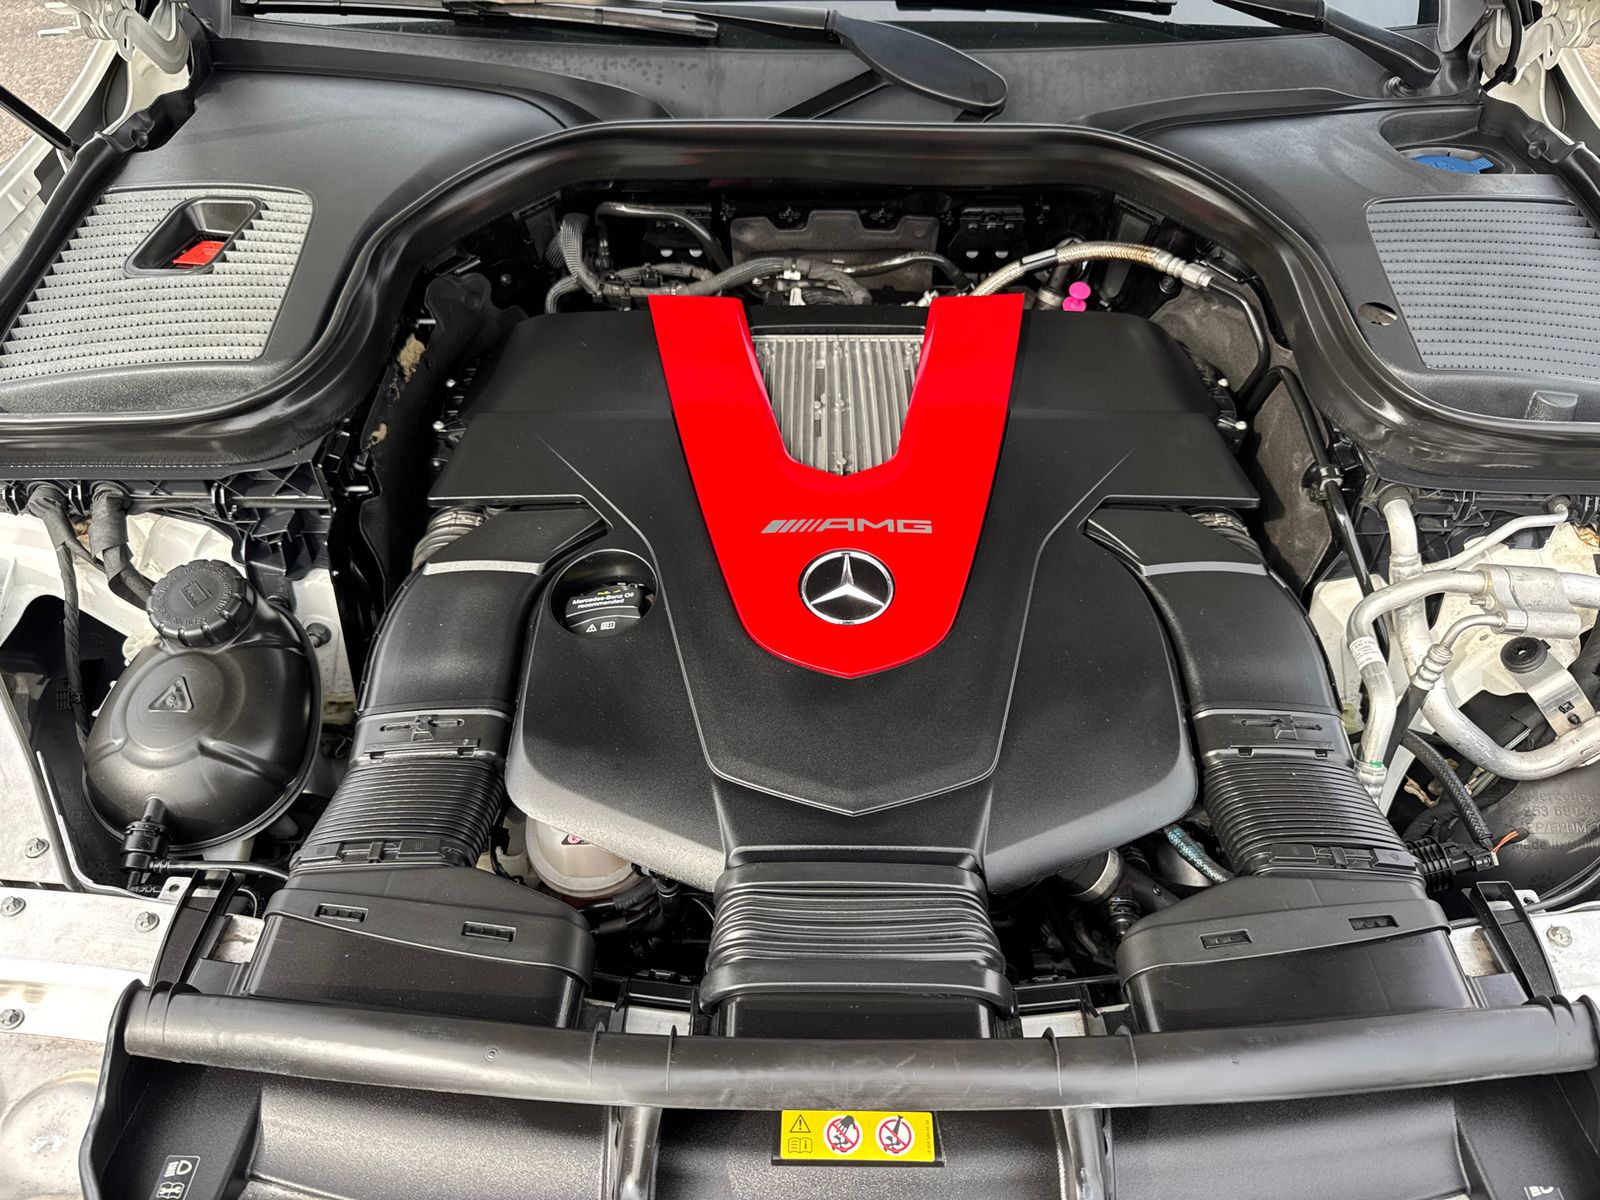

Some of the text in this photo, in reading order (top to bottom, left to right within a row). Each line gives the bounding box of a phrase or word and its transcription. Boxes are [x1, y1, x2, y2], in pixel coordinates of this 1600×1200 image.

[815, 518, 932, 533] AMG
[572, 594, 623, 605] Mercedes-Benz
[577, 598, 625, 609] recommended
